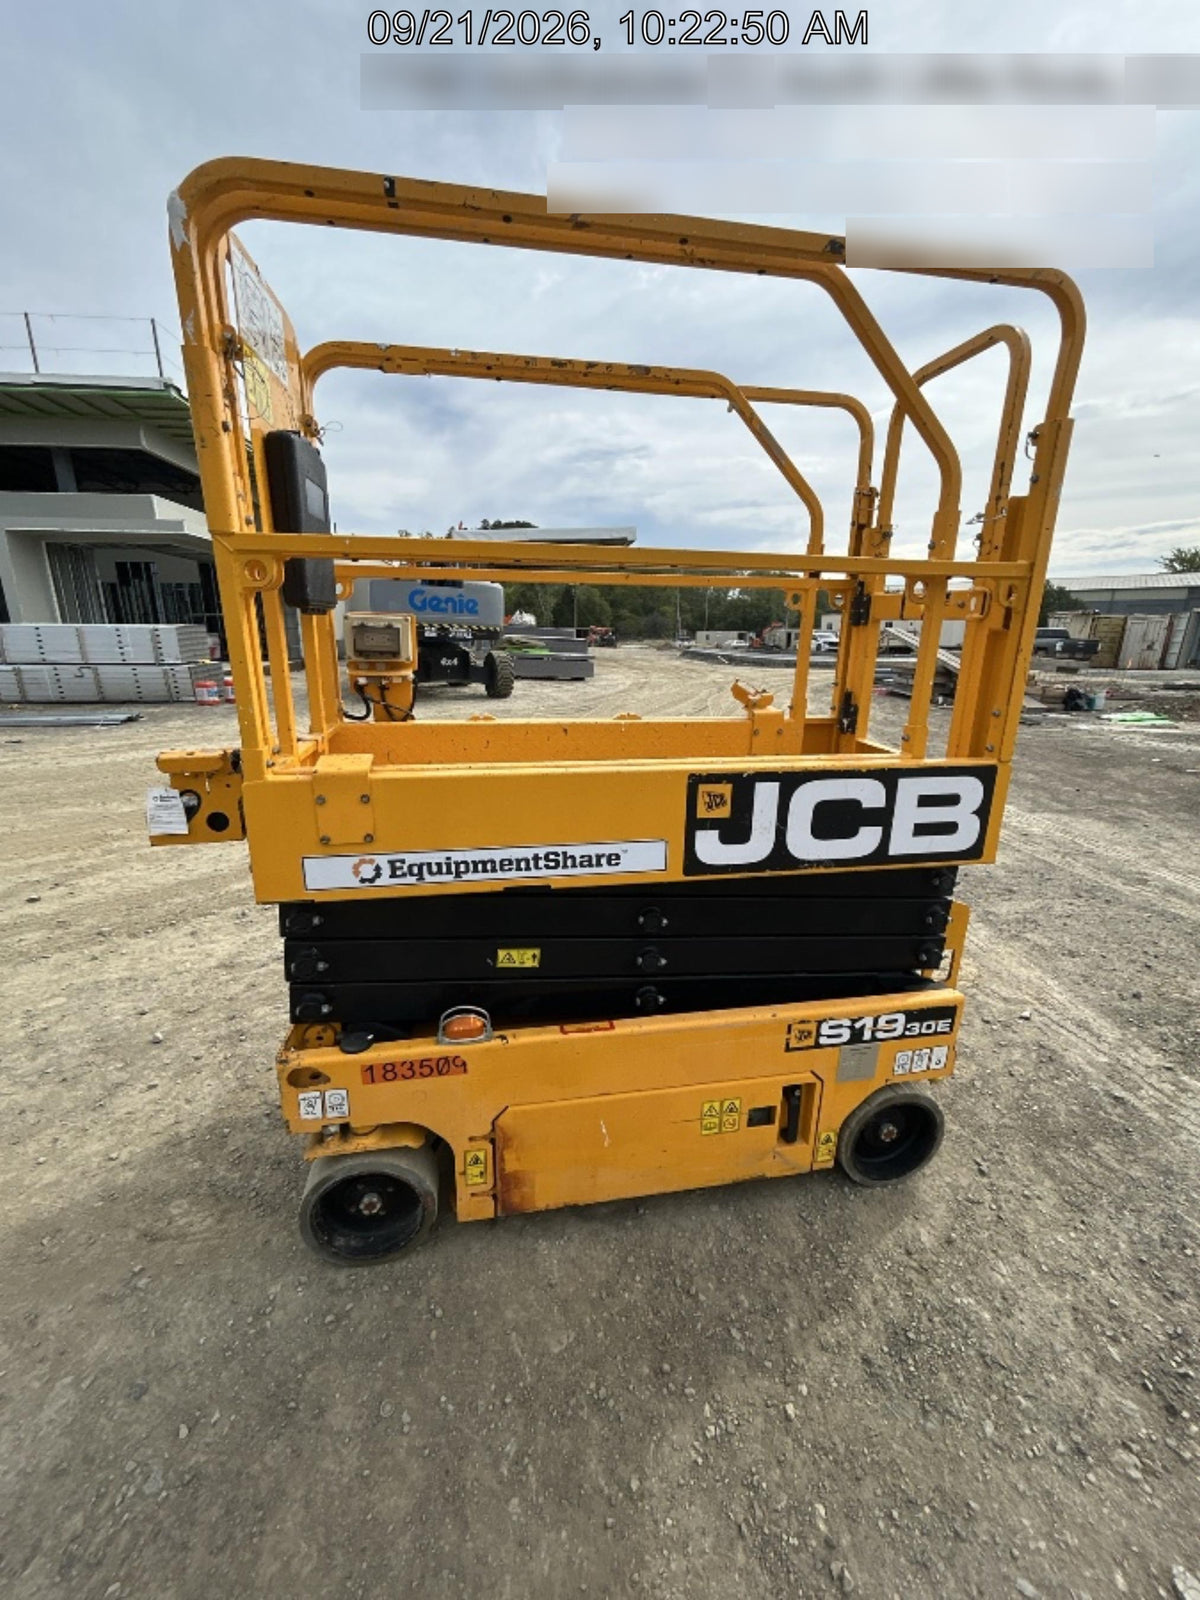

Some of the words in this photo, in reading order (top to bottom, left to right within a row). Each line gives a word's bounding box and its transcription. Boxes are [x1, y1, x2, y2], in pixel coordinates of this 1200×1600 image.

[408, 588, 479, 615] Genie
[694, 776, 984, 865] JCB
[363, 1056, 468, 1084] 183509
